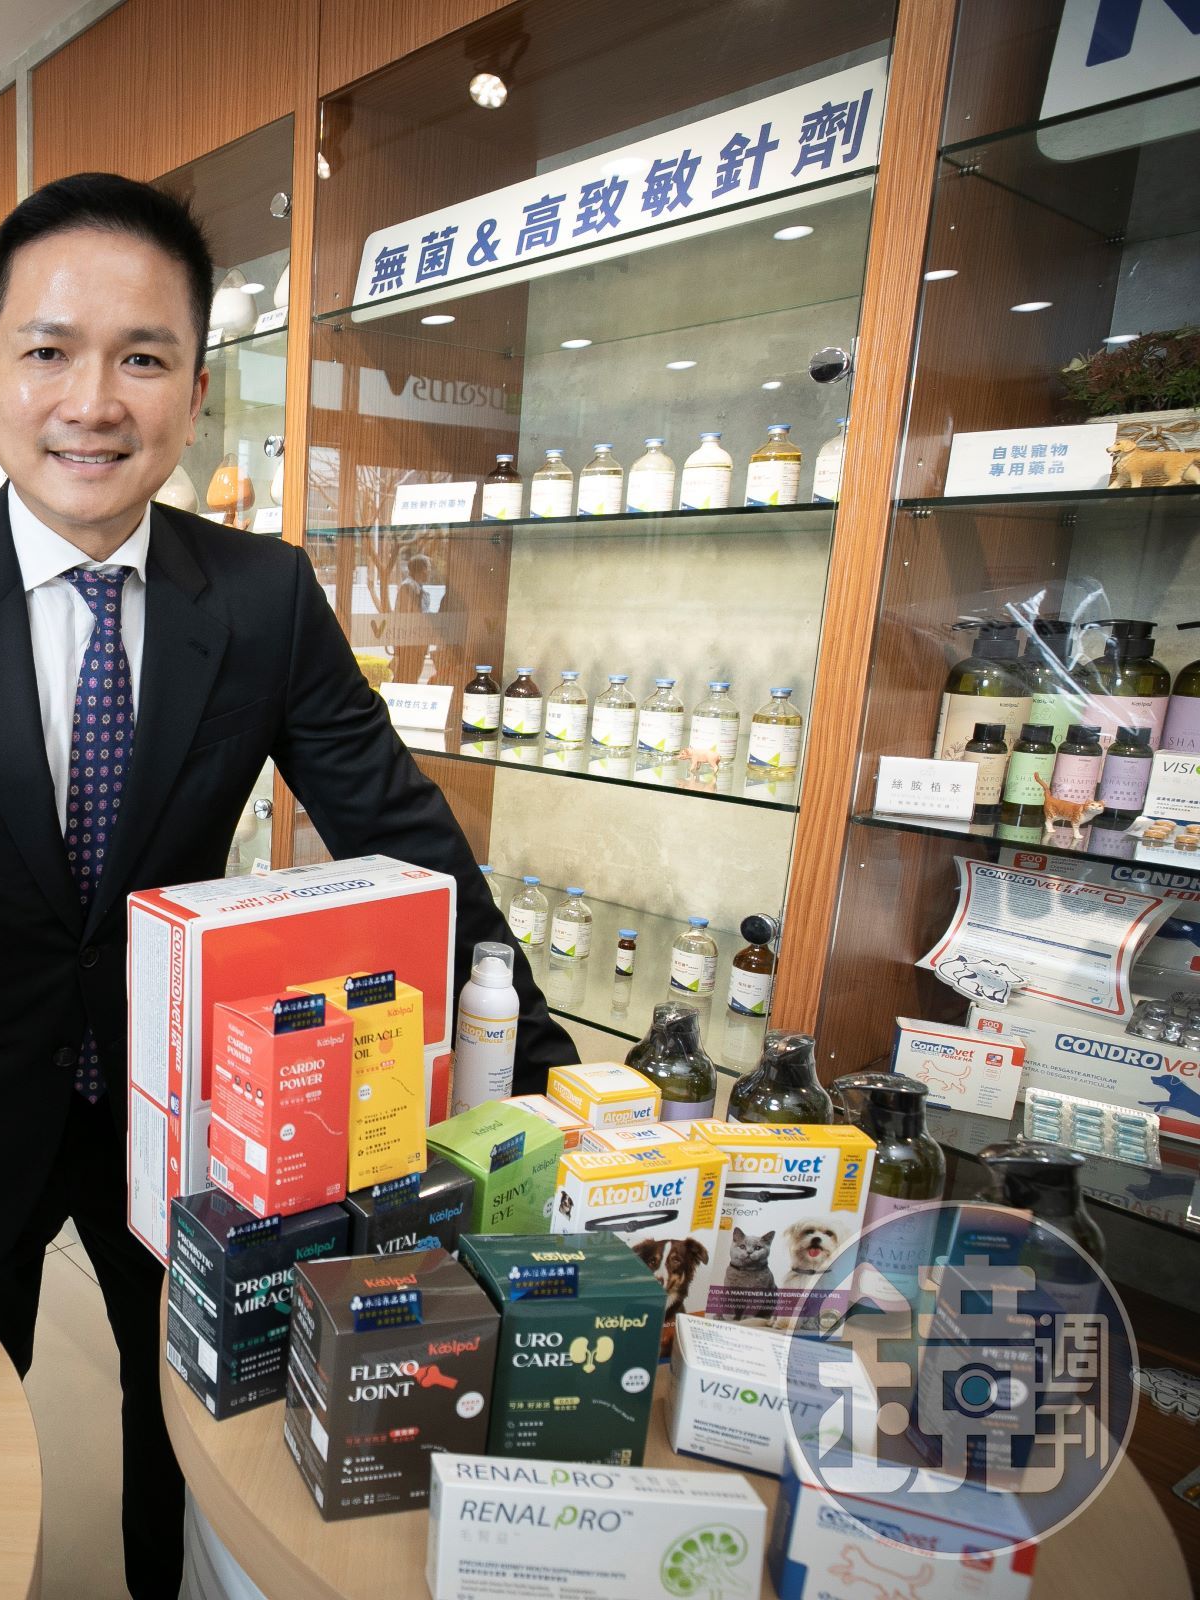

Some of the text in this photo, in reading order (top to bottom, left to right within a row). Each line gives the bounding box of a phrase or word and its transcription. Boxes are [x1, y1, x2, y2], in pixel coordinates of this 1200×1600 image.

[369, 89, 874, 297] 無菌&高致敏針劑
[991, 443, 1069, 461] 自製寵物
[988, 460, 1067, 477] 專用藥品
[1163, 761, 1200, 775] VISI
[170, 927, 184, 1032] CONDROvet
[226, 1034, 254, 1055] CARDIO
[354, 1027, 403, 1047] MIRACLE
[226, 1044, 253, 1065] POWER
[354, 1048, 373, 1060] OIL
[911, 1040, 976, 1058] Condrovet
[941, 1053, 961, 1061] FORCE
[280, 1058, 326, 1077] CARDIO
[1050, 1065, 1081, 1077] DESGASTE
[1082, 1072, 1118, 1084] ARTICULAR
[279, 1073, 323, 1091] POWER
[1046, 1070, 1079, 1082] DESGASTE
[1079, 1078, 1116, 1090] ARTICULAR
[604, 1107, 653, 1124] Atopivet
[782, 1172, 821, 1182] collar
[844, 1163, 860, 1179] 2
[492, 1180, 529, 1208] SHINY
[589, 1178, 686, 1208] Atopivet
[702, 1181, 715, 1197] 2
[648, 1196, 682, 1209] collar
[491, 1205, 515, 1226] EYE
[177, 1229, 215, 1270] PROBIOTIC
[375, 1233, 422, 1256] VITAL
[176, 1240, 208, 1276] MIRACLE
[731, 1290, 764, 1298] MANTENER
[774, 1291, 809, 1299] INTEGRIDAD
[515, 1332, 563, 1348] URO
[512, 1353, 574, 1368] CARE
[350, 1359, 420, 1382] FLEXO
[348, 1381, 415, 1403] JOINT
